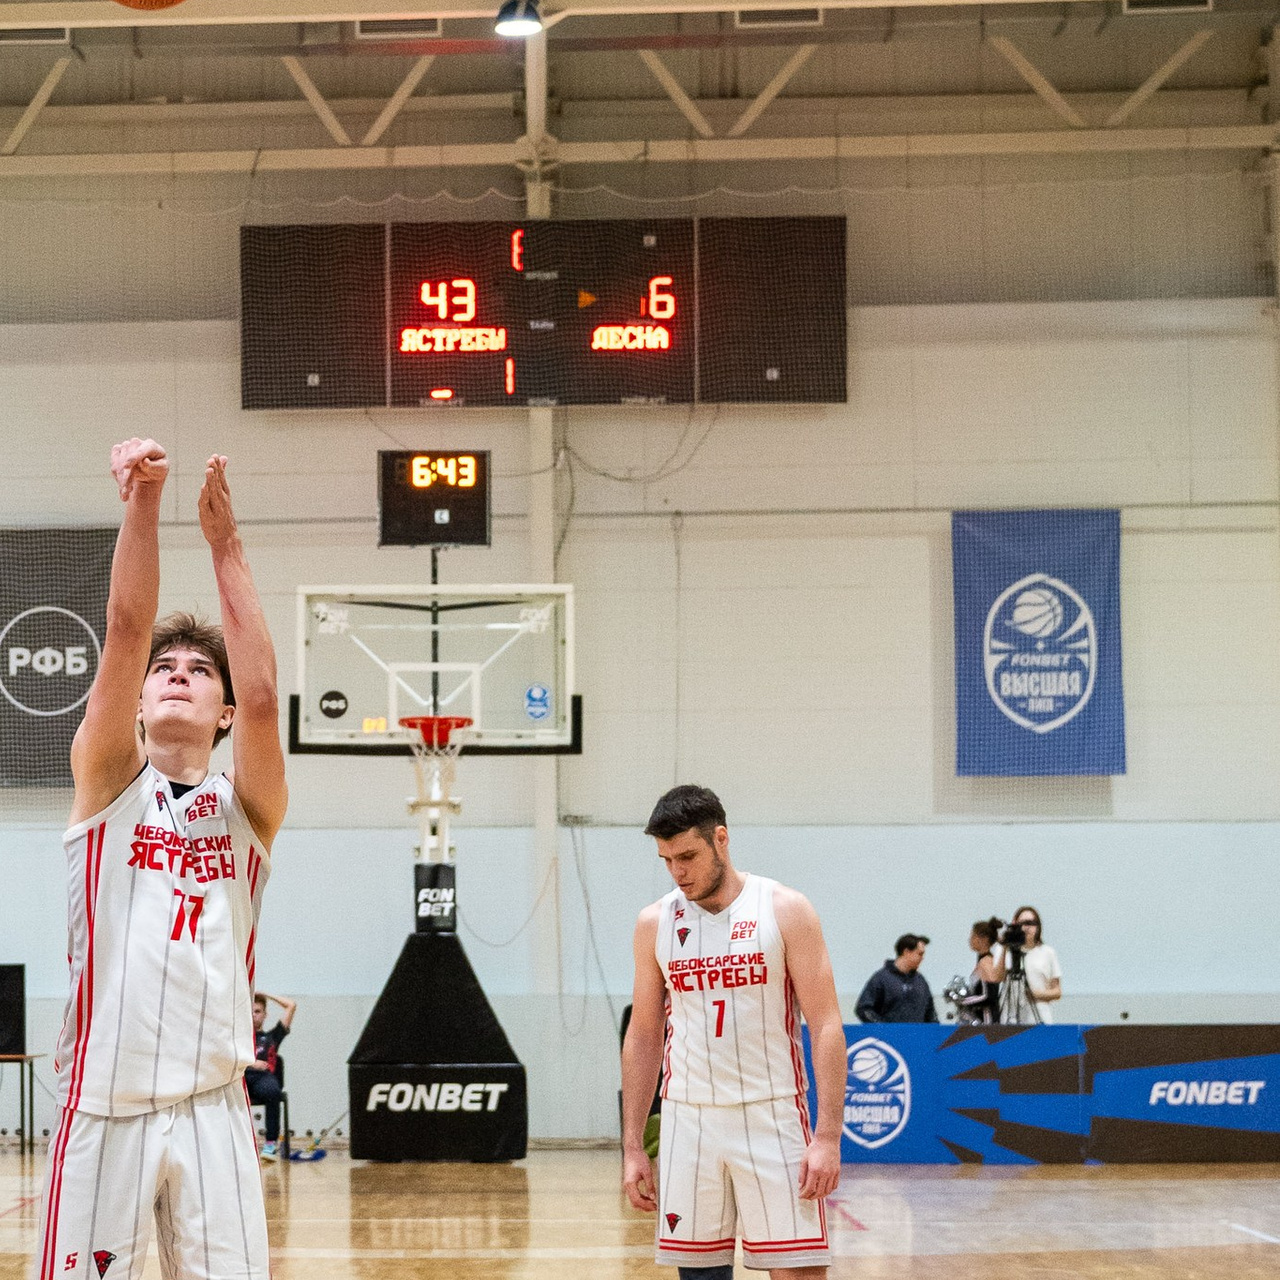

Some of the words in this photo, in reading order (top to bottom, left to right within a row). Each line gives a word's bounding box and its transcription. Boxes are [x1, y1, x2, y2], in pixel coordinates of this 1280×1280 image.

[421, 279, 476, 322] 43
[400, 327, 506, 352] ЯСТРЕБЫ
[591, 325, 670, 351] ДЕСНА
[412, 456, 476, 487] 6:43
[8, 647, 88, 676] РФБ
[1000, 672, 1081, 696] ВЫСШАЯ
[195, 793, 217, 807] ON
[187, 805, 218, 823] BET
[127, 841, 236, 884] ЯСТРЕБЫ
[418, 888, 454, 902] FON
[418, 902, 455, 917] BET
[731, 929, 755, 940] BET
[733, 921, 757, 931] FON
[668, 952, 765, 972] ЧЕБОКСАРСКИЕ
[669, 966, 768, 993] ЯСТРЕБЫ
[712, 1000, 726, 1038] 7
[366, 1083, 508, 1112] FONBET
[1149, 1081, 1266, 1105] FONBET
